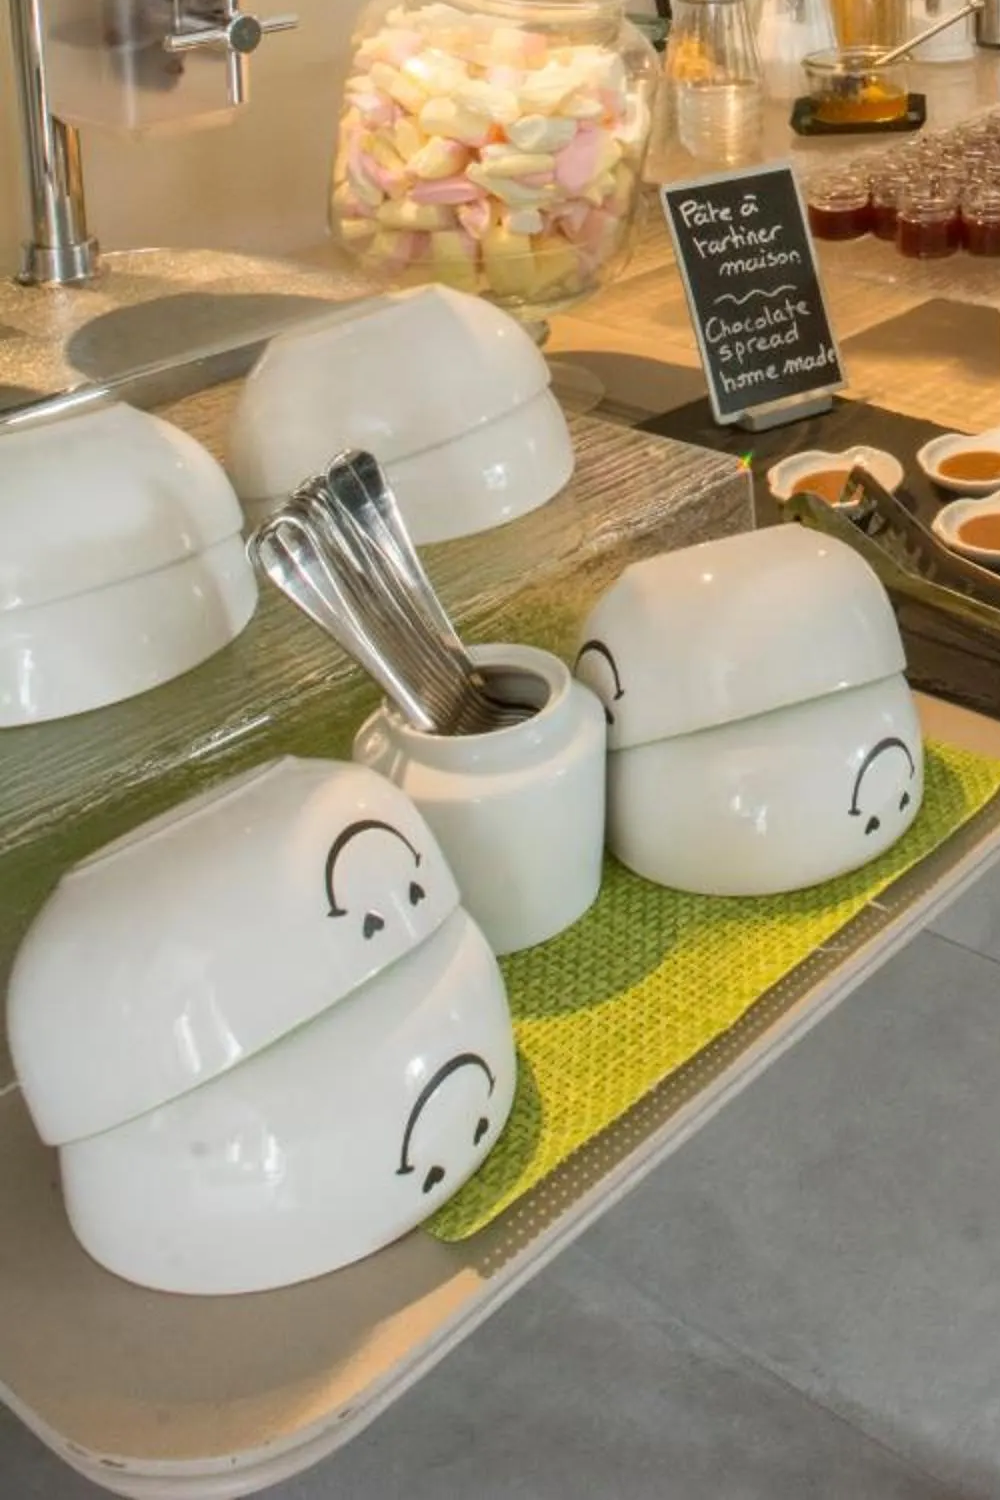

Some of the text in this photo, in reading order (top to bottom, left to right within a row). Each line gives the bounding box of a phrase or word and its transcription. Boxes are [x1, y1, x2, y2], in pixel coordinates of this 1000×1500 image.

[693, 224, 783, 258] tartiner
[719, 250, 801, 276] maison
[705, 300, 811, 343] Chocolate
[719, 324, 800, 364] spread
[720, 344, 836, 393] home made
